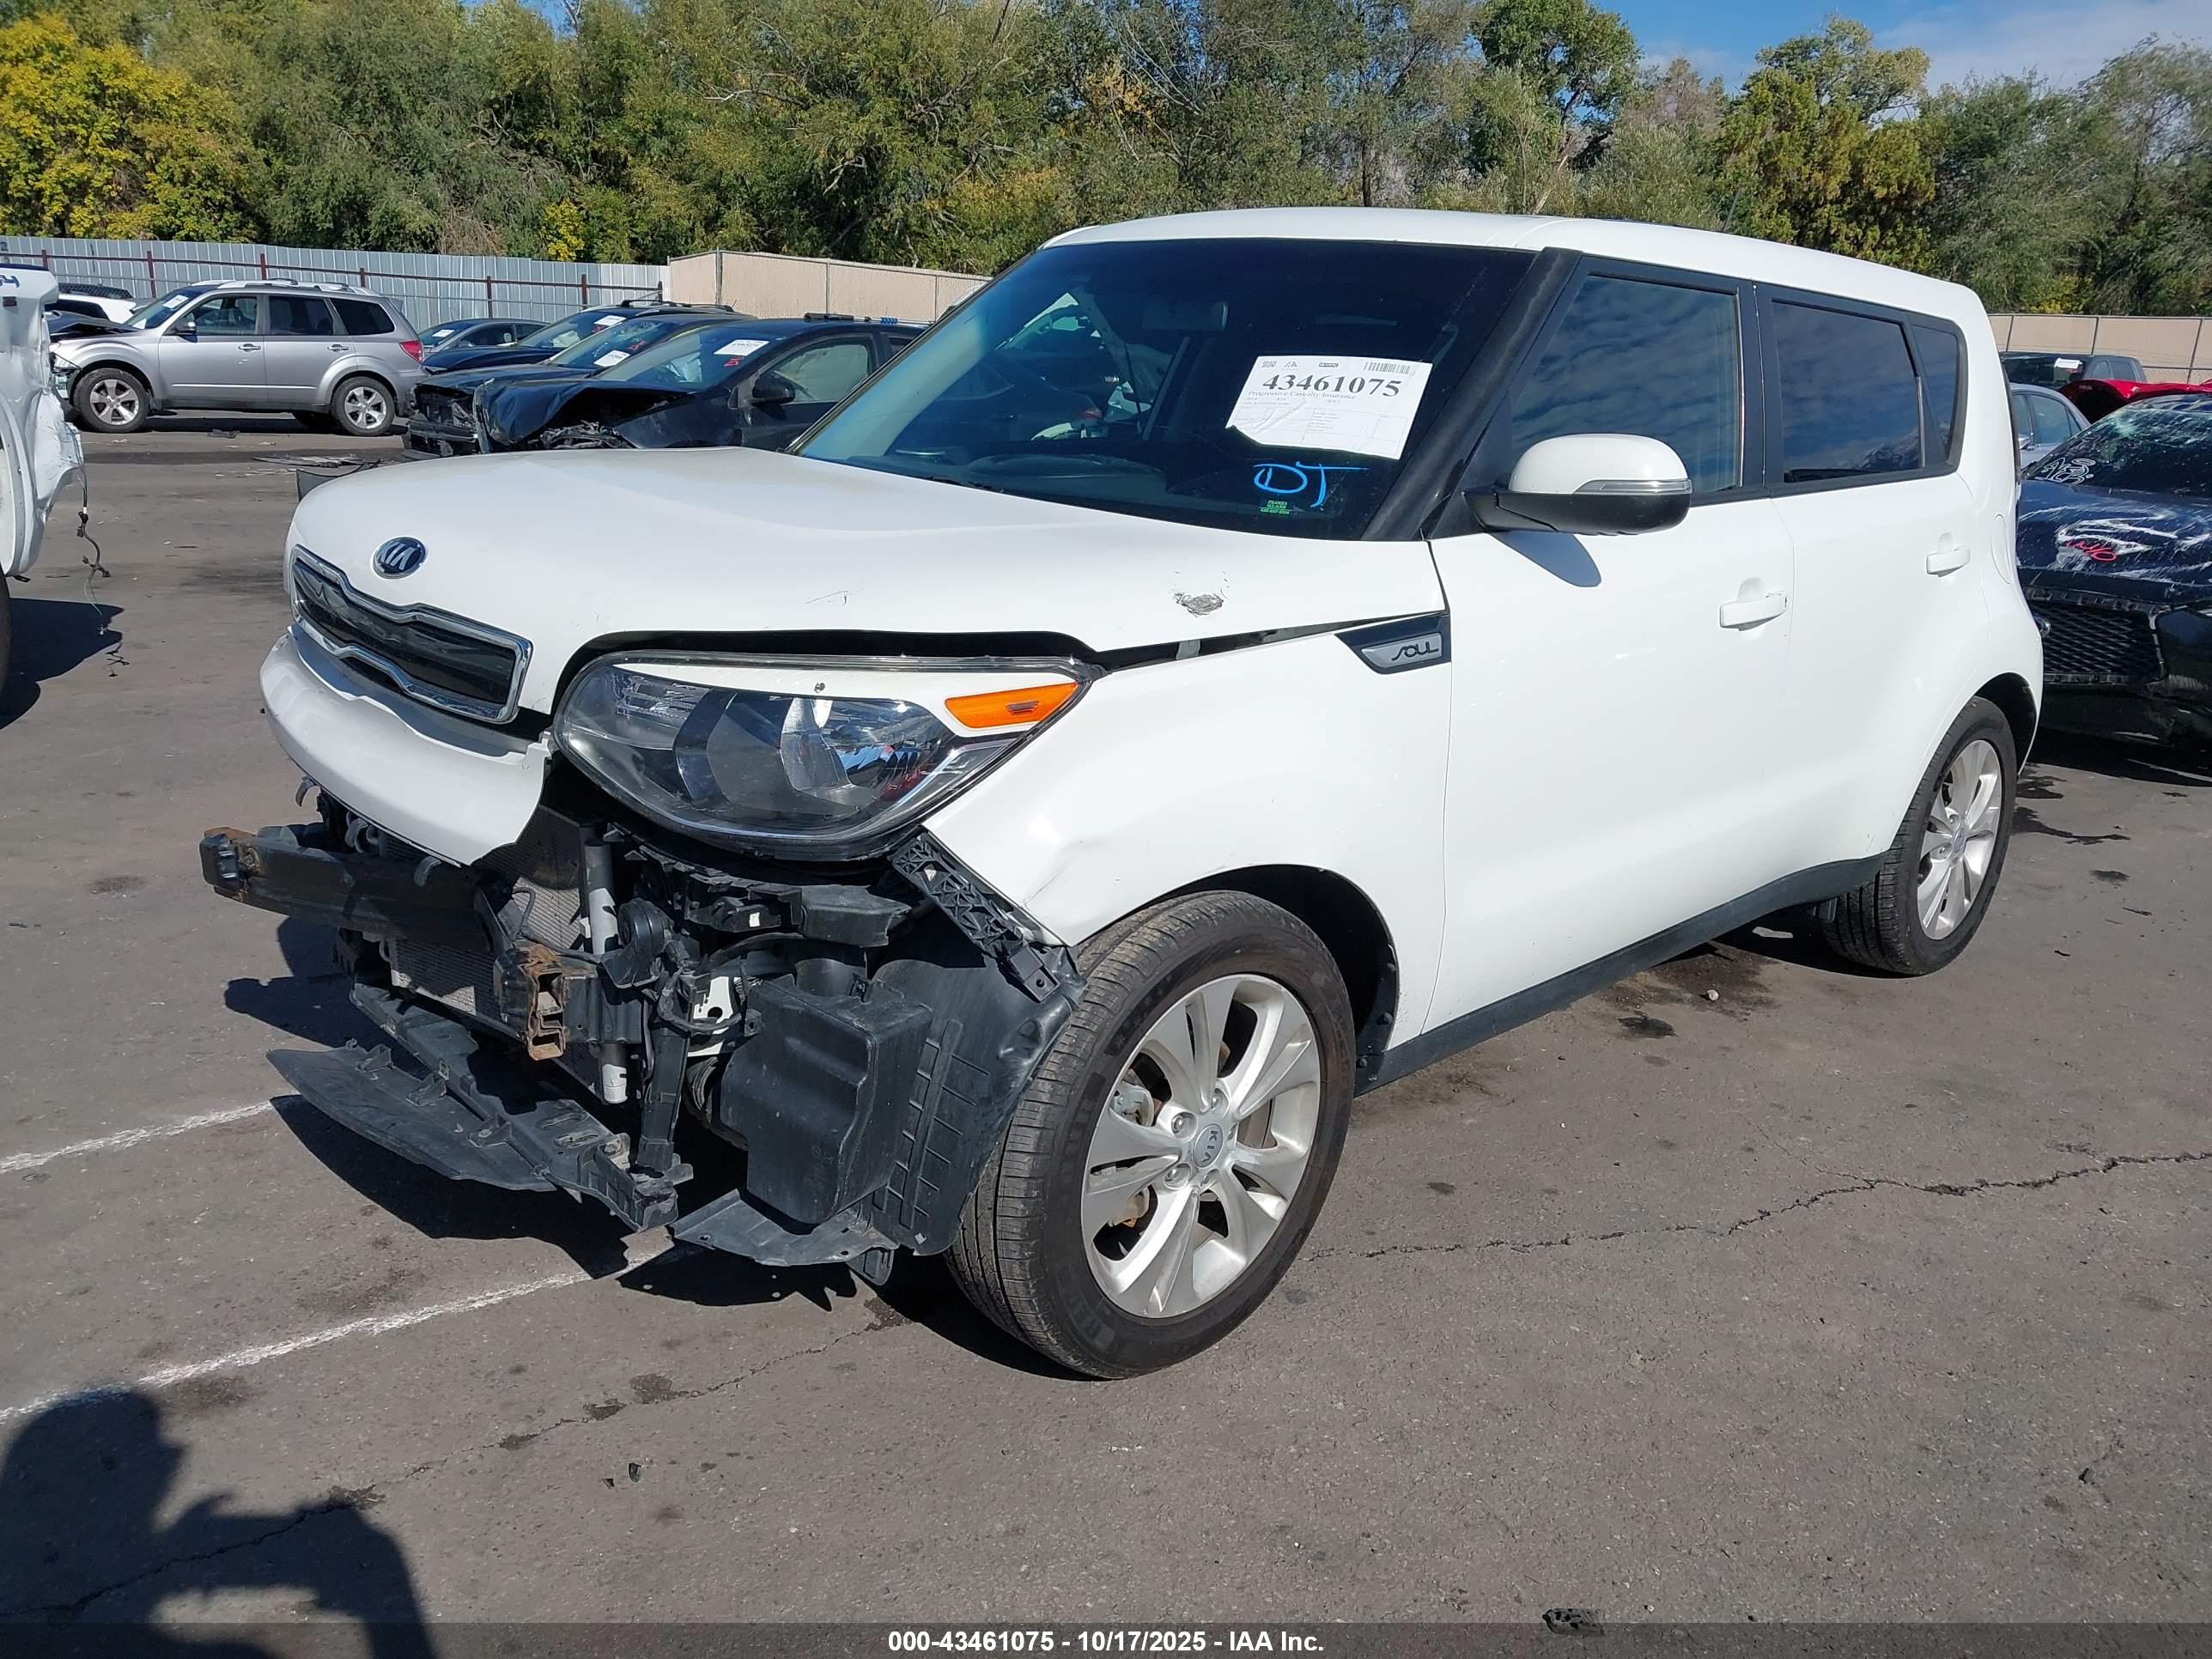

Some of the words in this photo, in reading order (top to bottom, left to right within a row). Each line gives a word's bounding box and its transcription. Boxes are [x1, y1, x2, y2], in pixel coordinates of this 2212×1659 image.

[1262, 374, 1402, 398] 43461075
[377, 541, 417, 571] KIA
[1201, 1130, 1218, 1162] KIA
